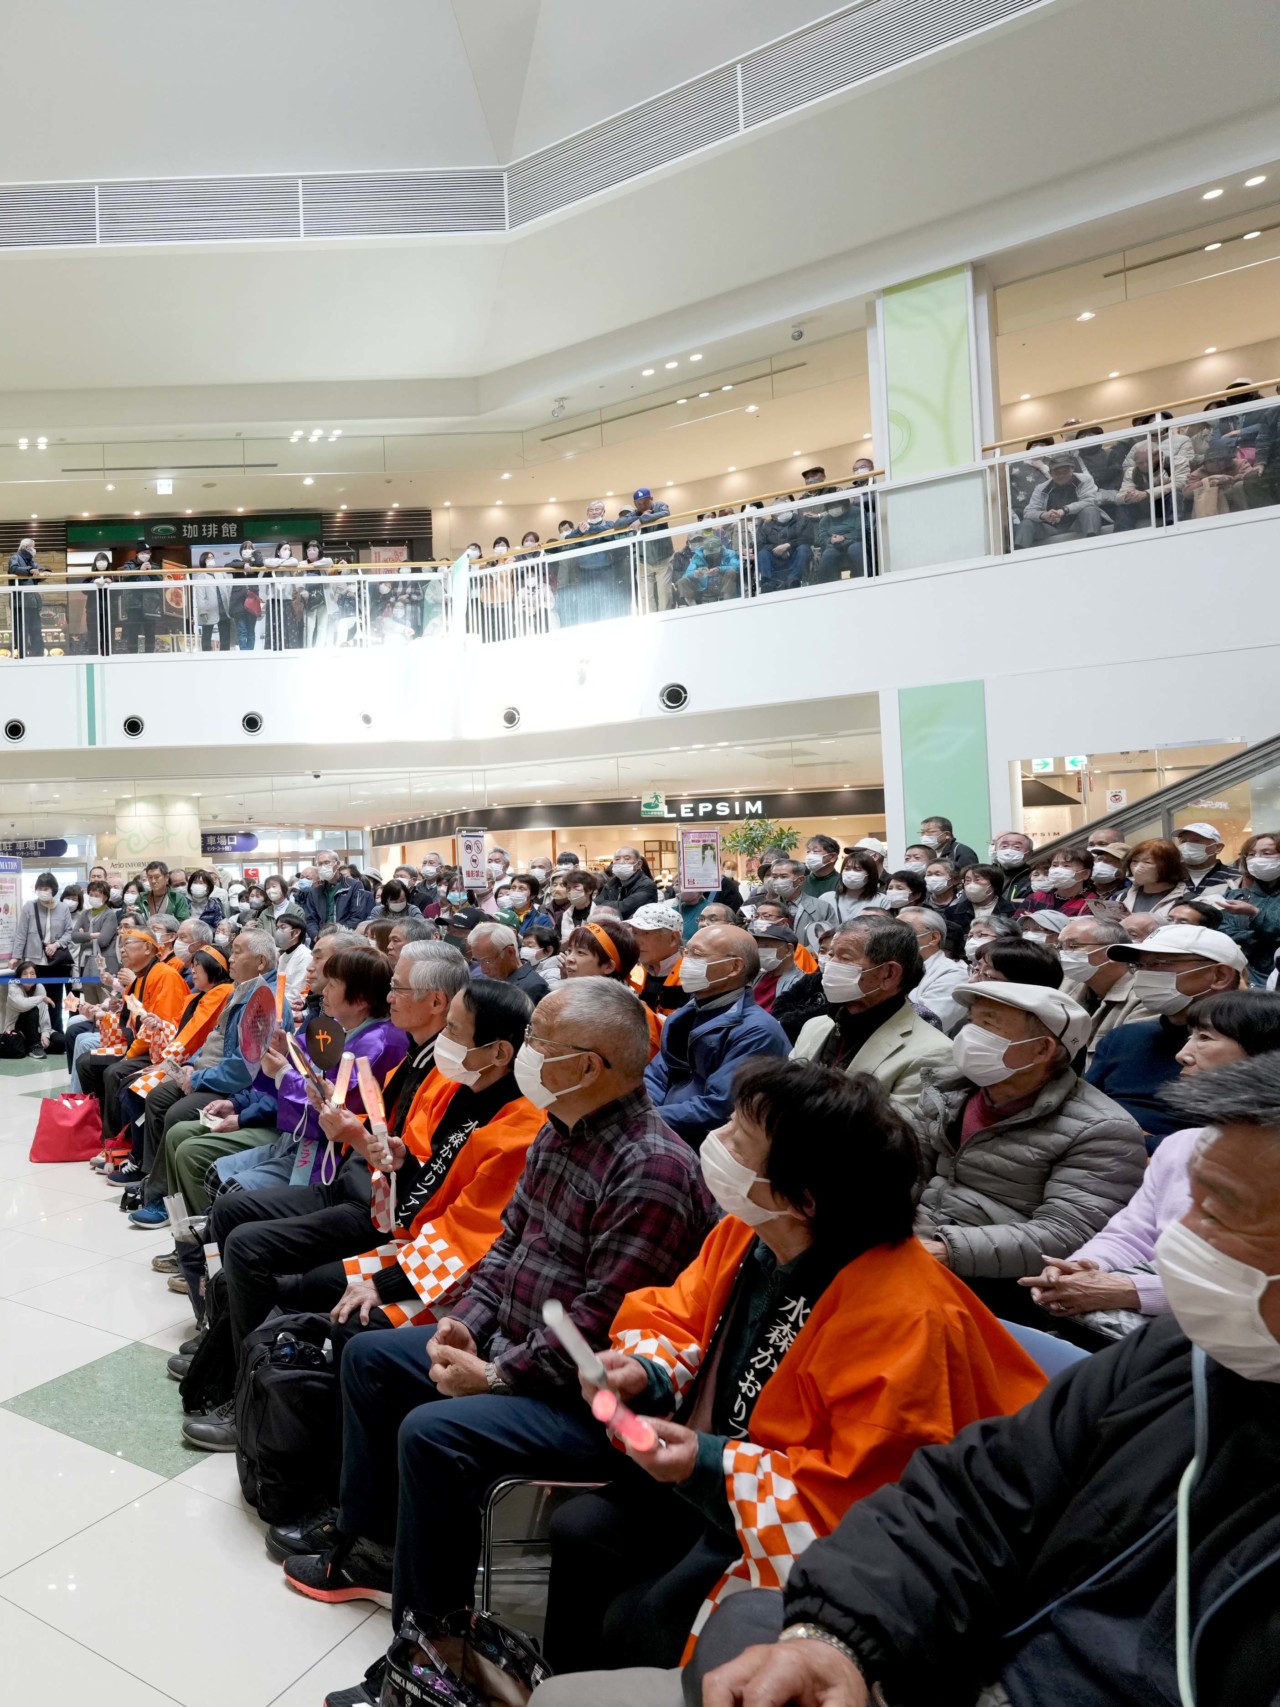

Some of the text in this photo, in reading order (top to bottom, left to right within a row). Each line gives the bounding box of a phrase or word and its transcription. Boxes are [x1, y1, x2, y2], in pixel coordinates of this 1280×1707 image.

[182, 523, 237, 538] 珈琲館
[663, 800, 762, 818] LEPSIM
[315, 1029, 332, 1052] や
